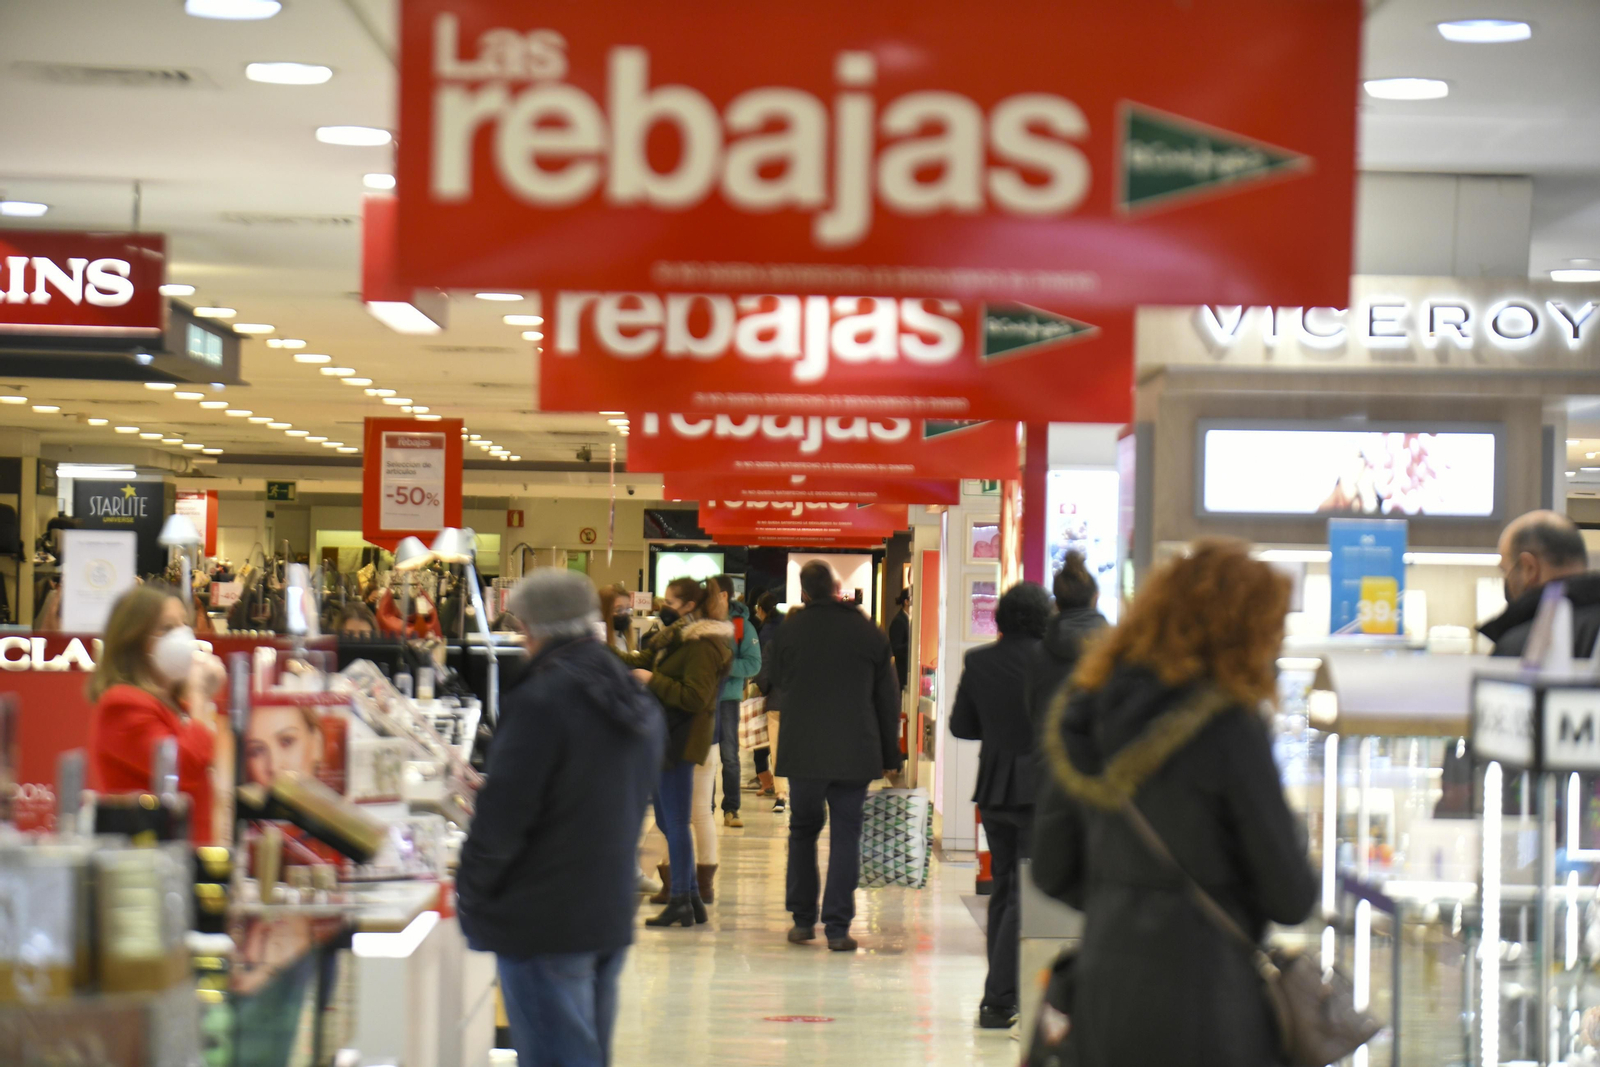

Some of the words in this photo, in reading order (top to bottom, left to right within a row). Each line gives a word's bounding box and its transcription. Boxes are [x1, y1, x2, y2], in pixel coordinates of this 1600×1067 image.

[433, 12, 568, 80] Las
[431, 46, 1093, 249] rebajas
[0, 256, 134, 308] INS
[554, 291, 964, 384] rebajas
[1200, 299, 1599, 348] VICEROY
[89, 496, 149, 517] STARLITE
[102, 516, 135, 524] UNIVERSE
[386, 485, 440, 507] -50%
